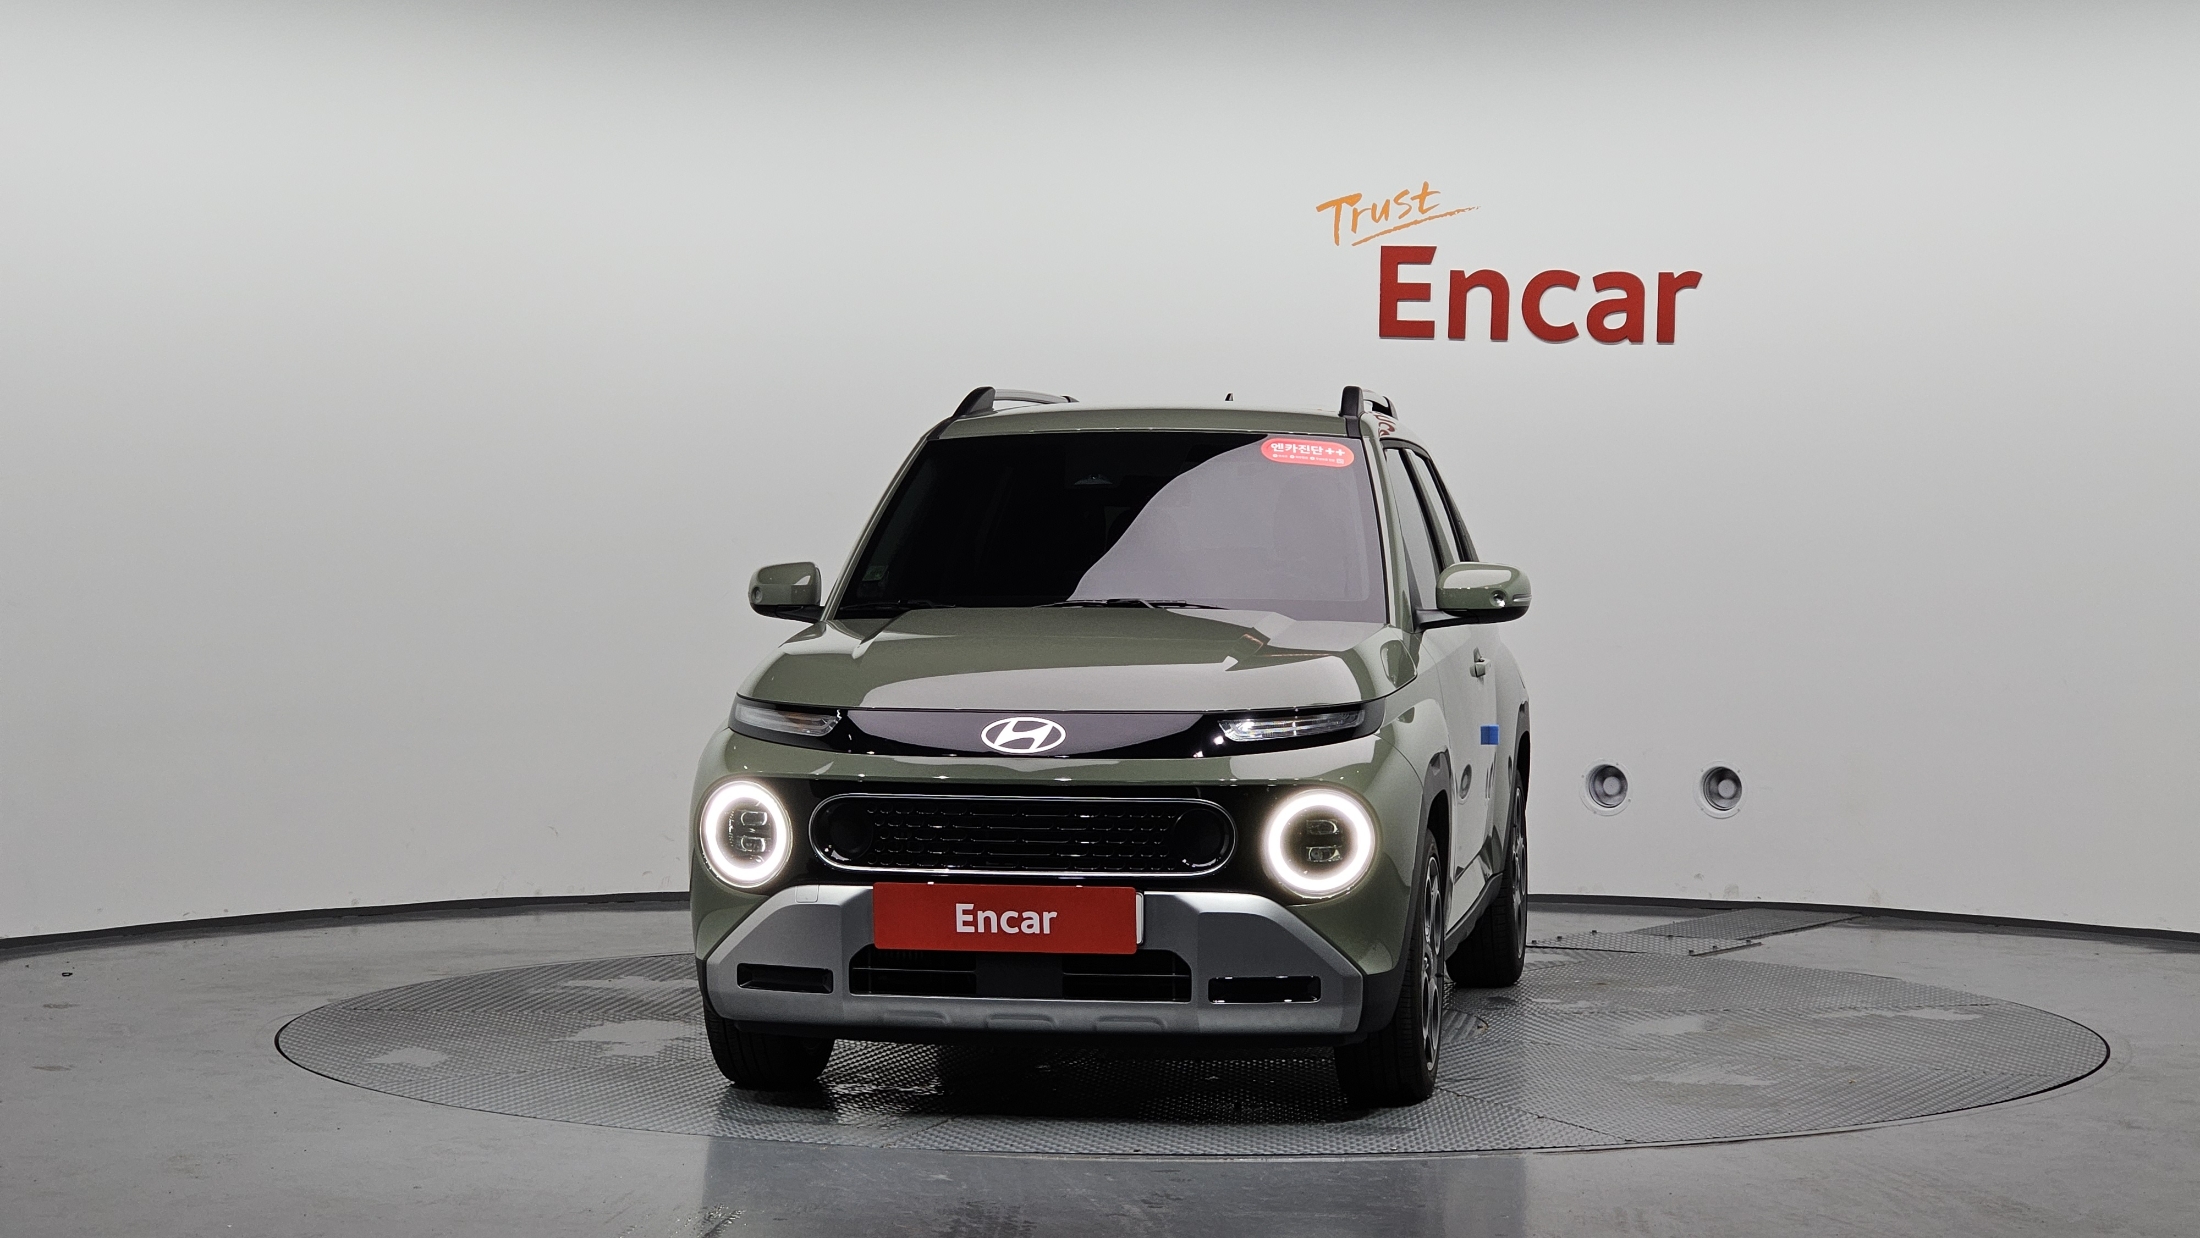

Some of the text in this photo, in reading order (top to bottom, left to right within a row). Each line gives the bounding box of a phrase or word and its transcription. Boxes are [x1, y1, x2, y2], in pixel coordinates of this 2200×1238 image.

[1316, 181, 1441, 246] Trust
[1378, 245, 1703, 344] Encar
[955, 903, 1058, 935] Encar
